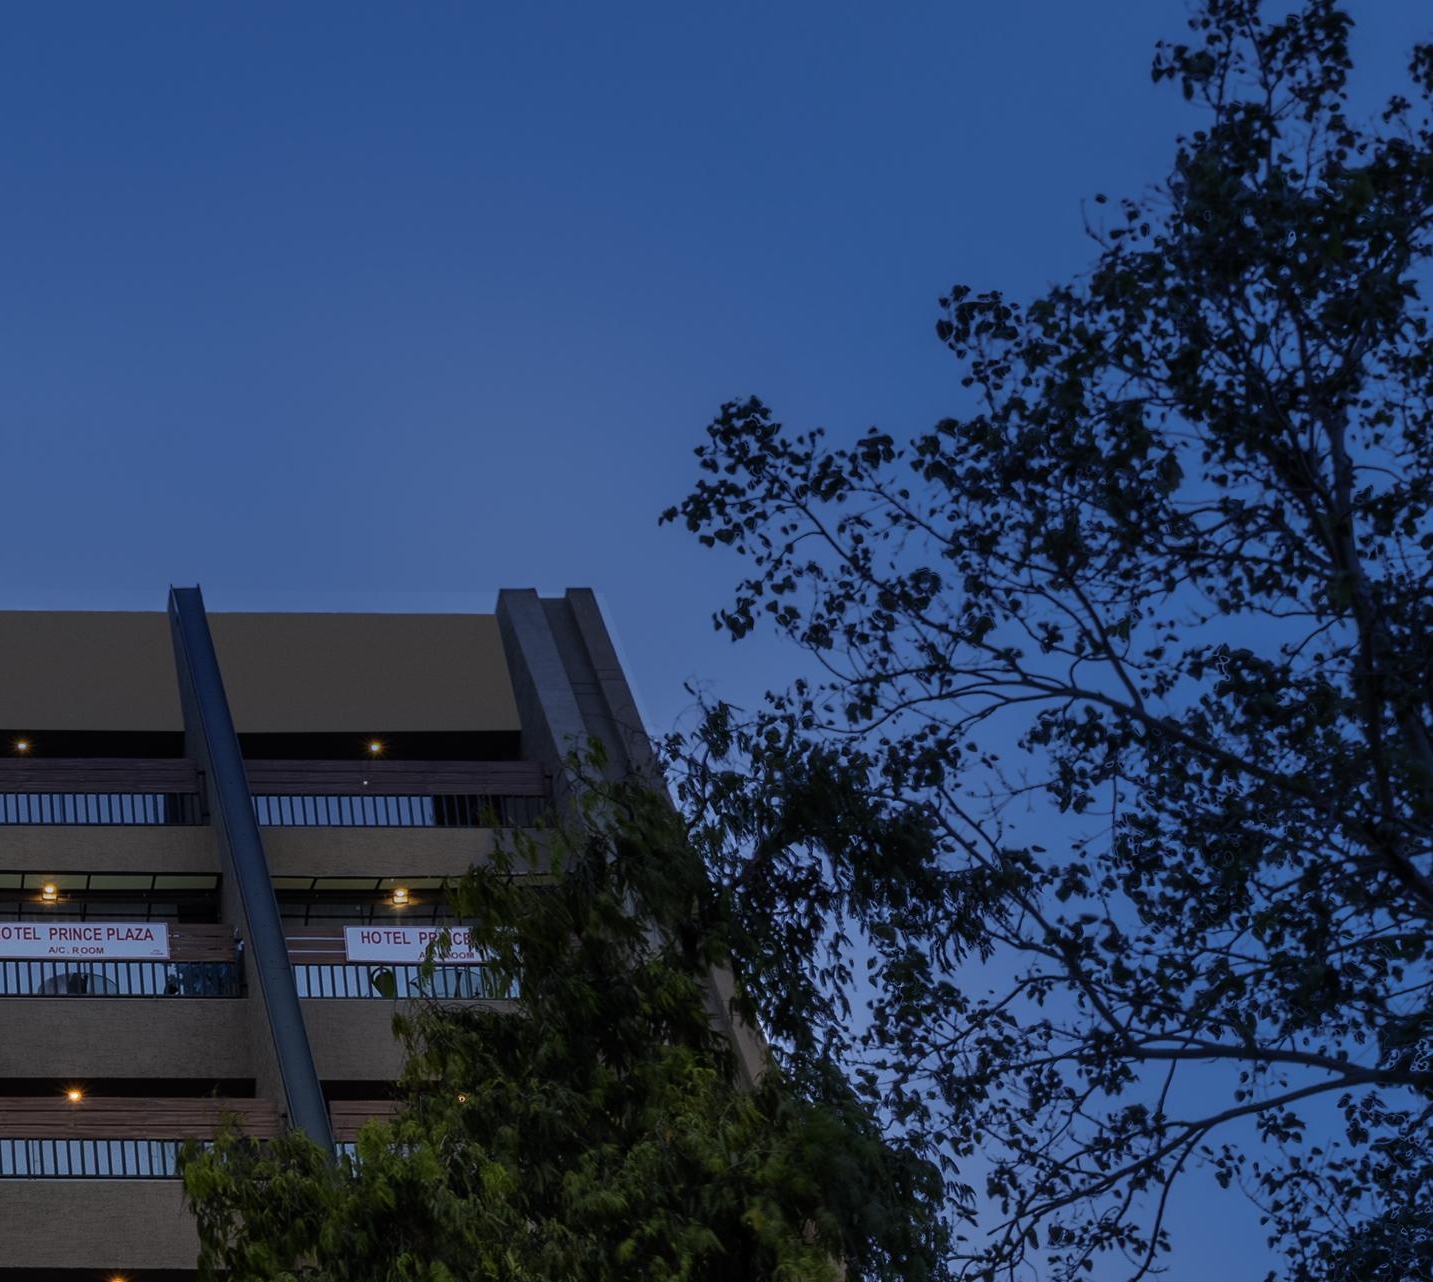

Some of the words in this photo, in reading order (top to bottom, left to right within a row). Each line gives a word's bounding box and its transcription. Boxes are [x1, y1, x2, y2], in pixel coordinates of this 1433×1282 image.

[48, 927, 103, 941] PRINCE
[106, 927, 154, 942] PLAZA
[360, 930, 411, 945] HOTEL
